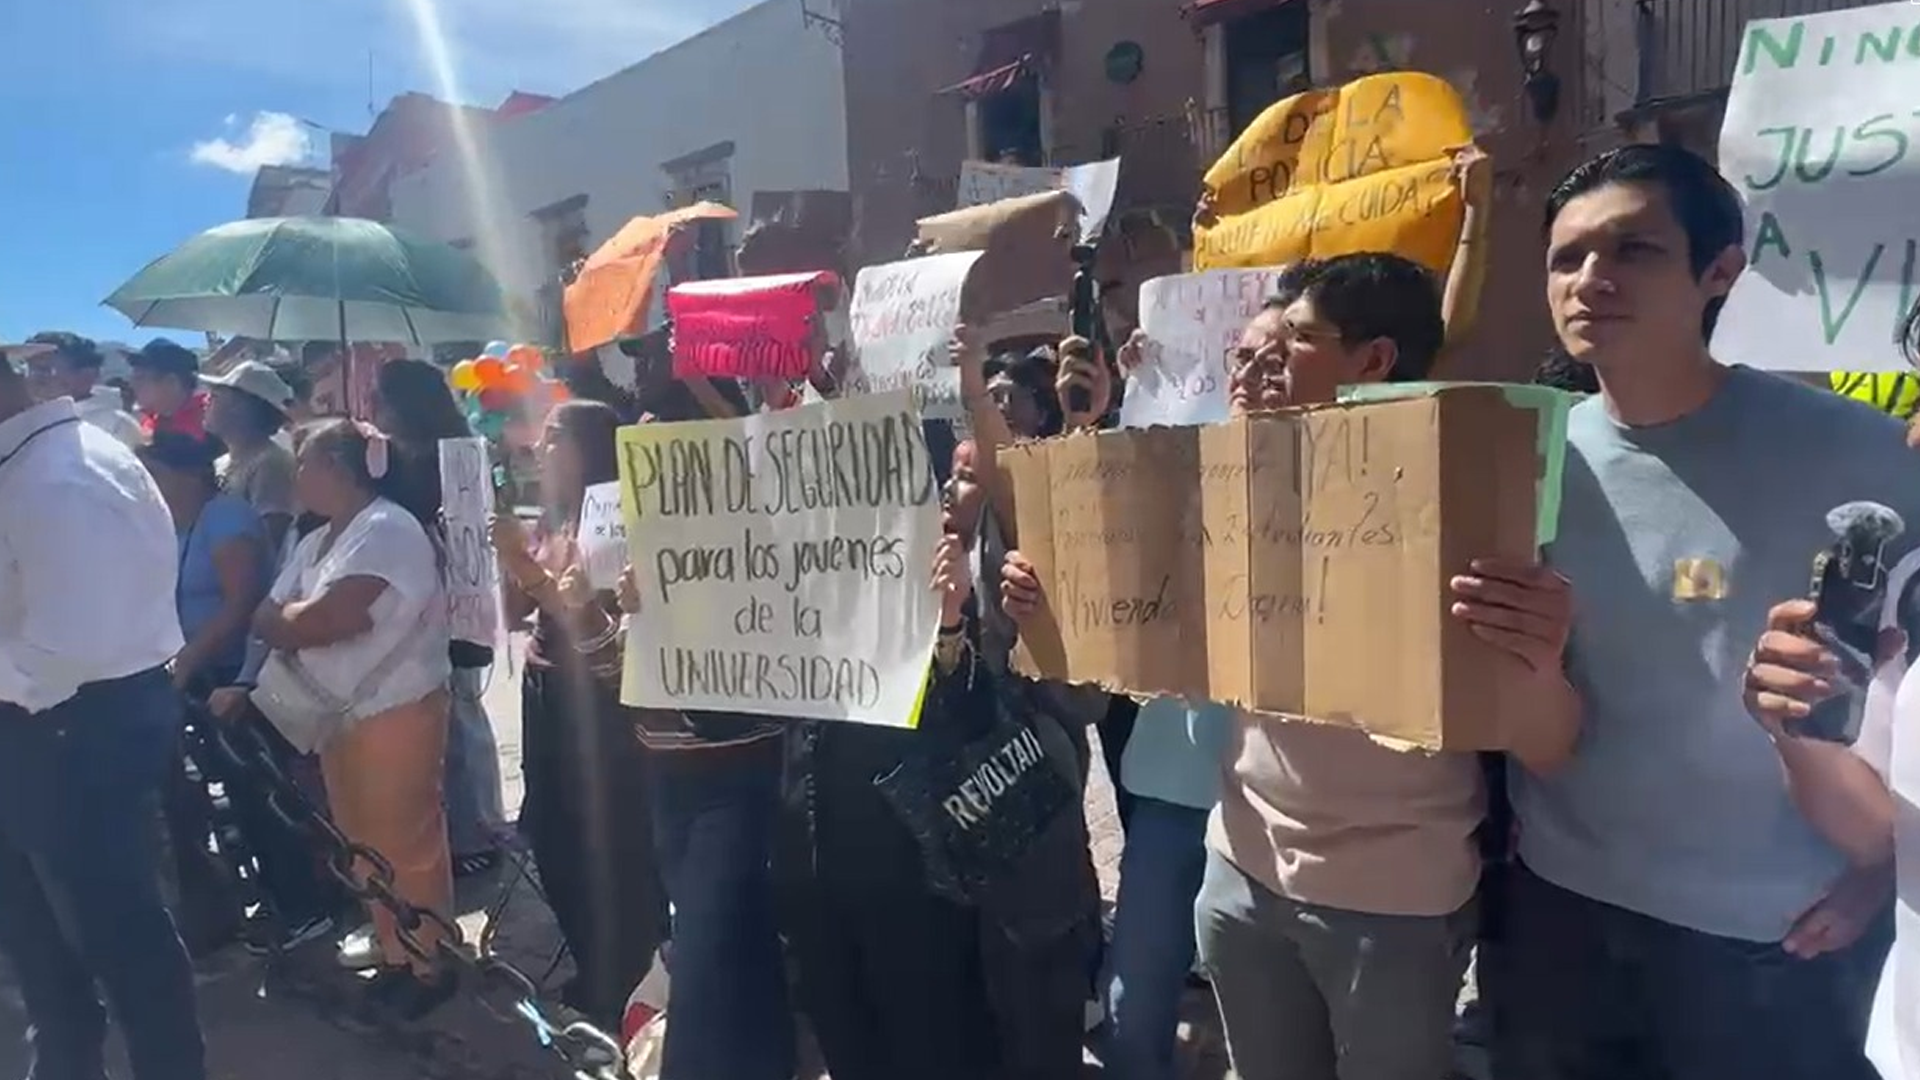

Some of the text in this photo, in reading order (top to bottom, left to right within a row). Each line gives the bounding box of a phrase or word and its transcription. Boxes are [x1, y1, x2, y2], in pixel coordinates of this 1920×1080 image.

[1346, 83, 1405, 126] LA
[1744, 110, 1920, 192] JUS
[1749, 211, 1792, 266] A
[624, 411, 934, 519] PLAN DE SEGURIDAD
[656, 528, 906, 603] para los jovenes
[734, 596, 822, 638] de la
[660, 646, 881, 709] UNIVERSIDAD
